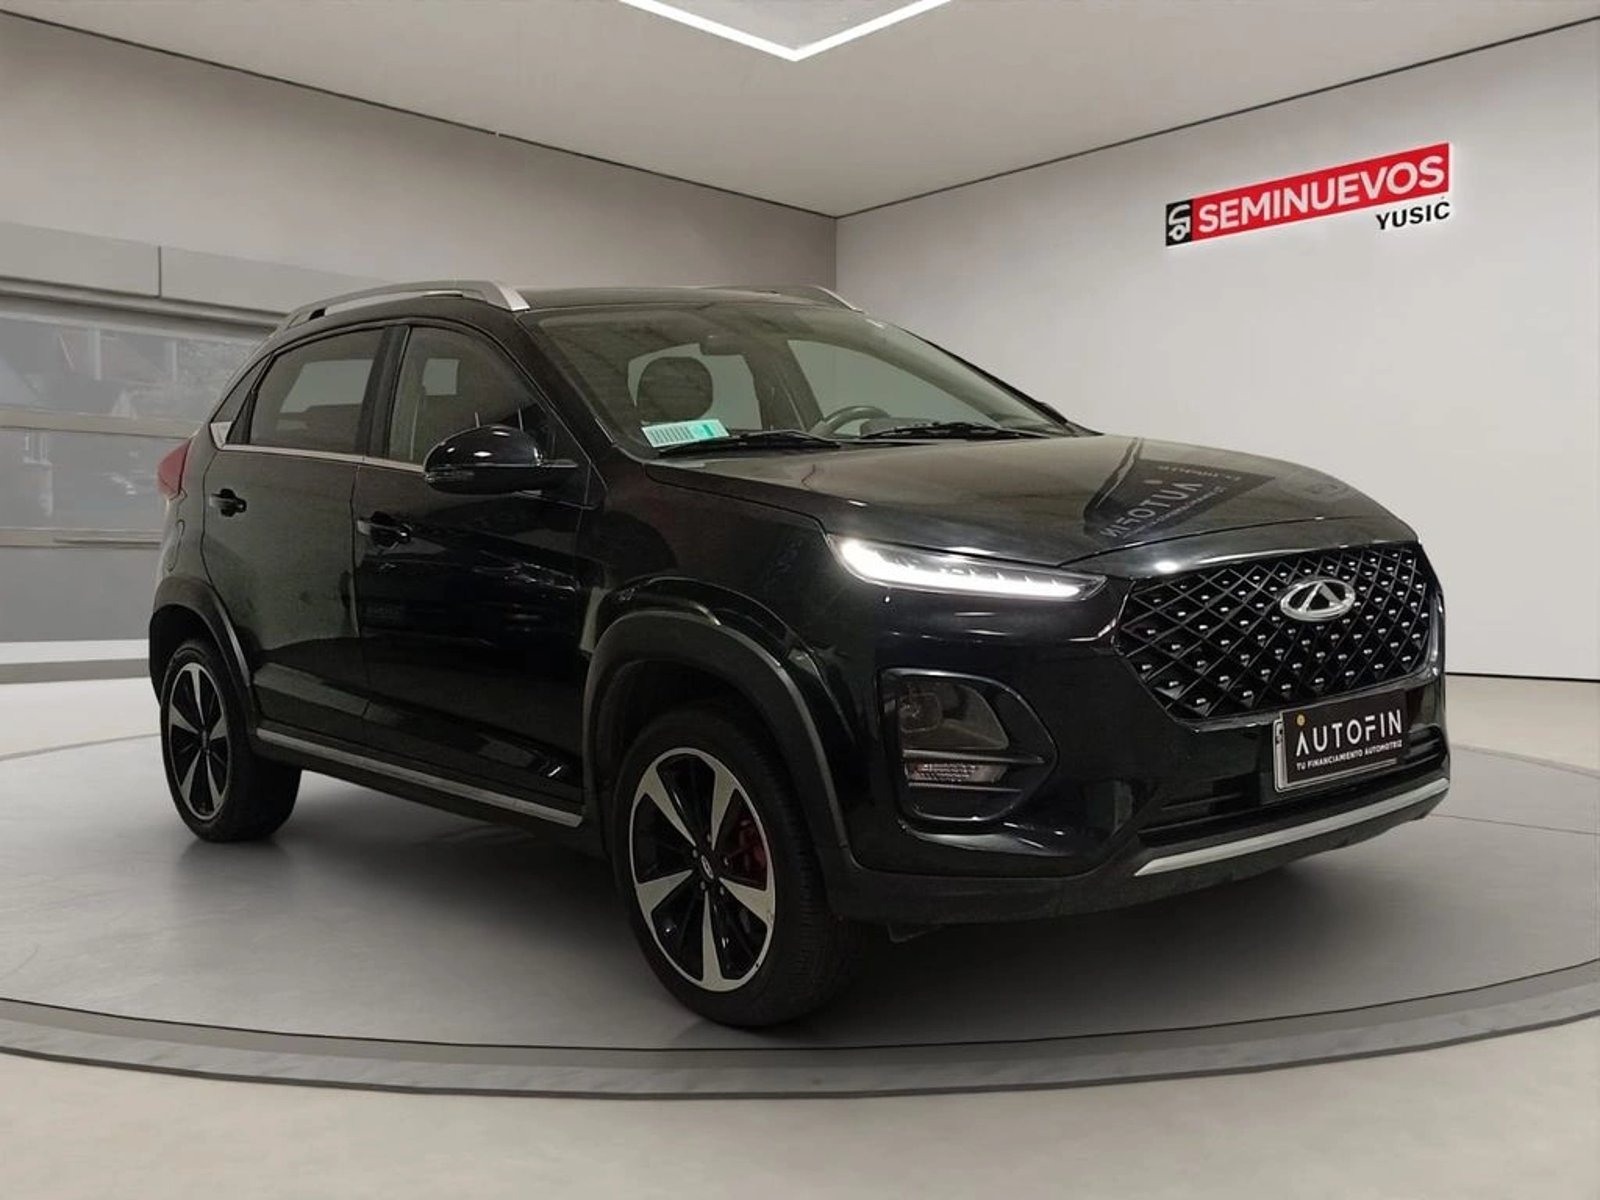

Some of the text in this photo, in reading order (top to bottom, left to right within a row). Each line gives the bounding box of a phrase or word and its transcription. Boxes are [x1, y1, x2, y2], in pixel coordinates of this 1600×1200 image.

[1198, 155, 1445, 233] SEMINUEVOS
[1375, 201, 1451, 231] YUSIC
[1296, 709, 1402, 757] AUTOFIN
[1296, 739, 1403, 771] TU FINANCIAMIENTO AUTOMOTRIZ
